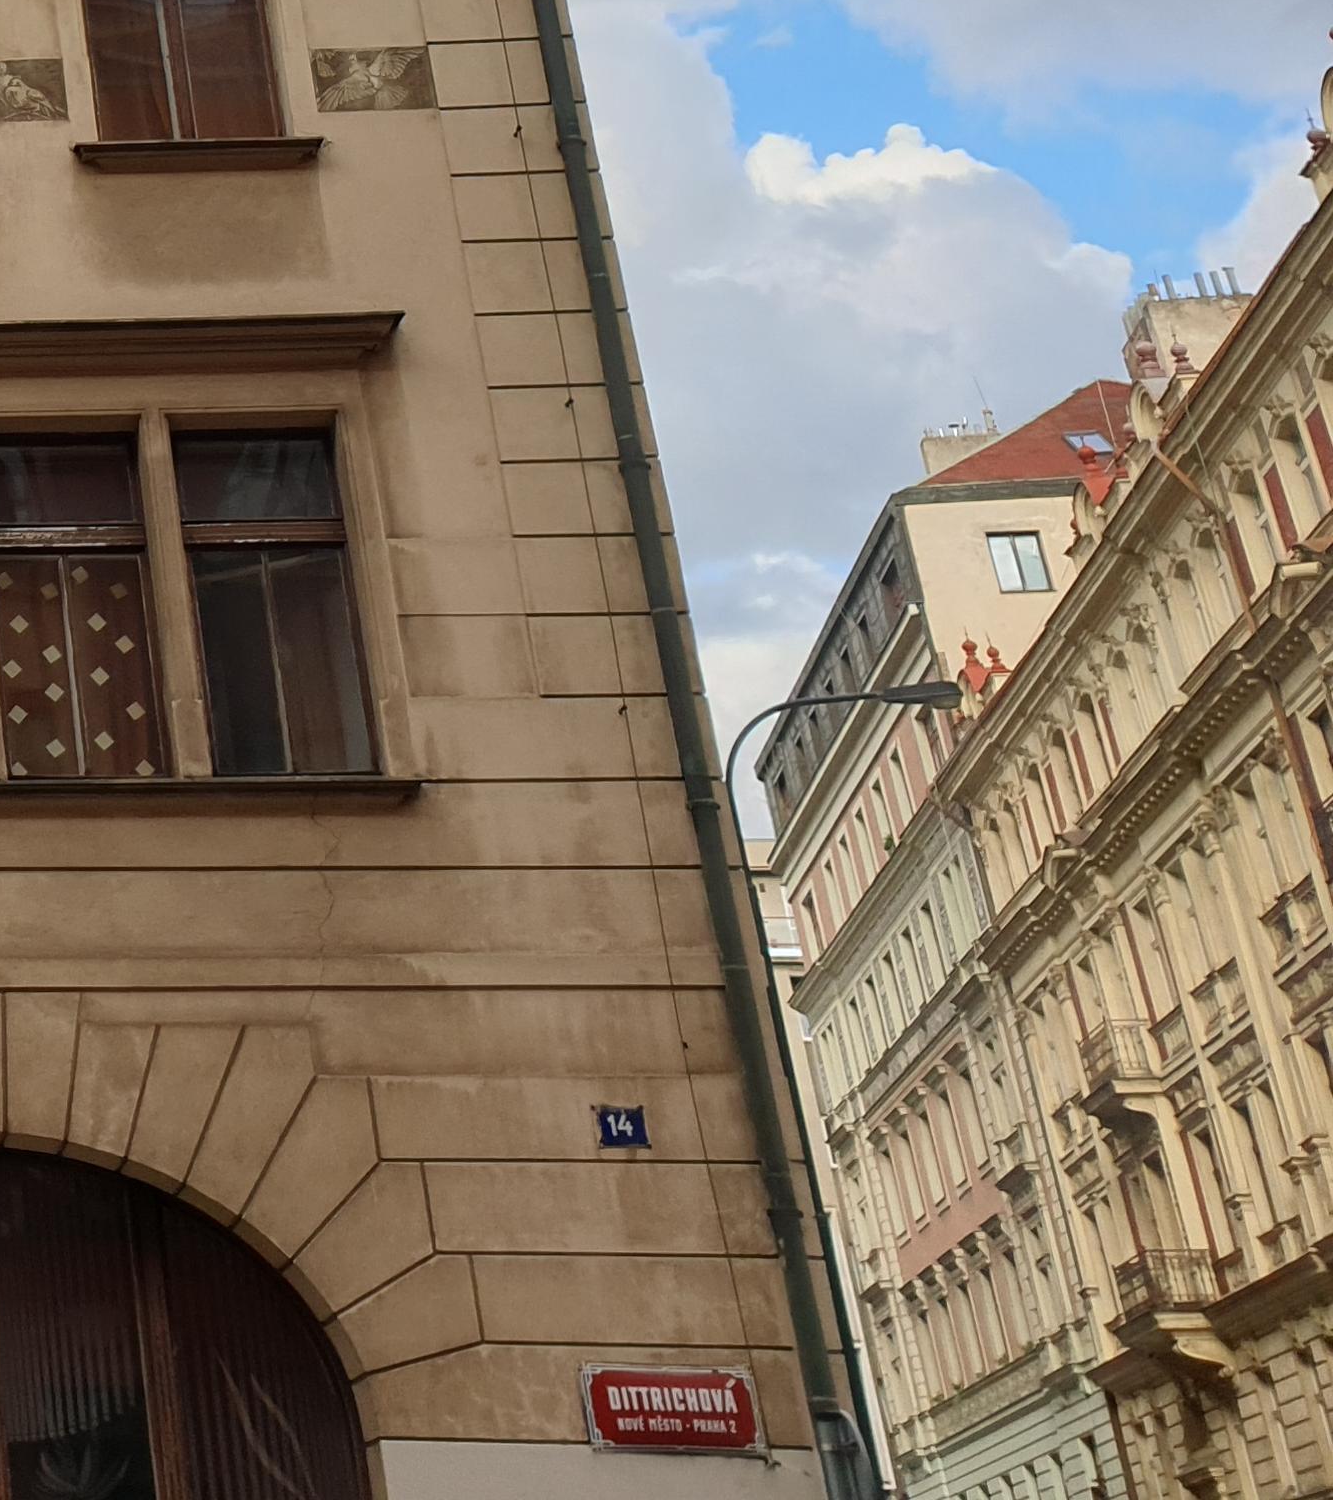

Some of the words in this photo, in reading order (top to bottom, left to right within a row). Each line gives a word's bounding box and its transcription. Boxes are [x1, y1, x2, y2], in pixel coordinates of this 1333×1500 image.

[607, 1113, 633, 1137] 14
[607, 1379, 738, 1414] DITTRICHOVÁ
[617, 1414, 645, 1431] NOVÉ
[649, 1414, 683, 1432] MĚSTO
[729, 1419, 737, 1434] 2
